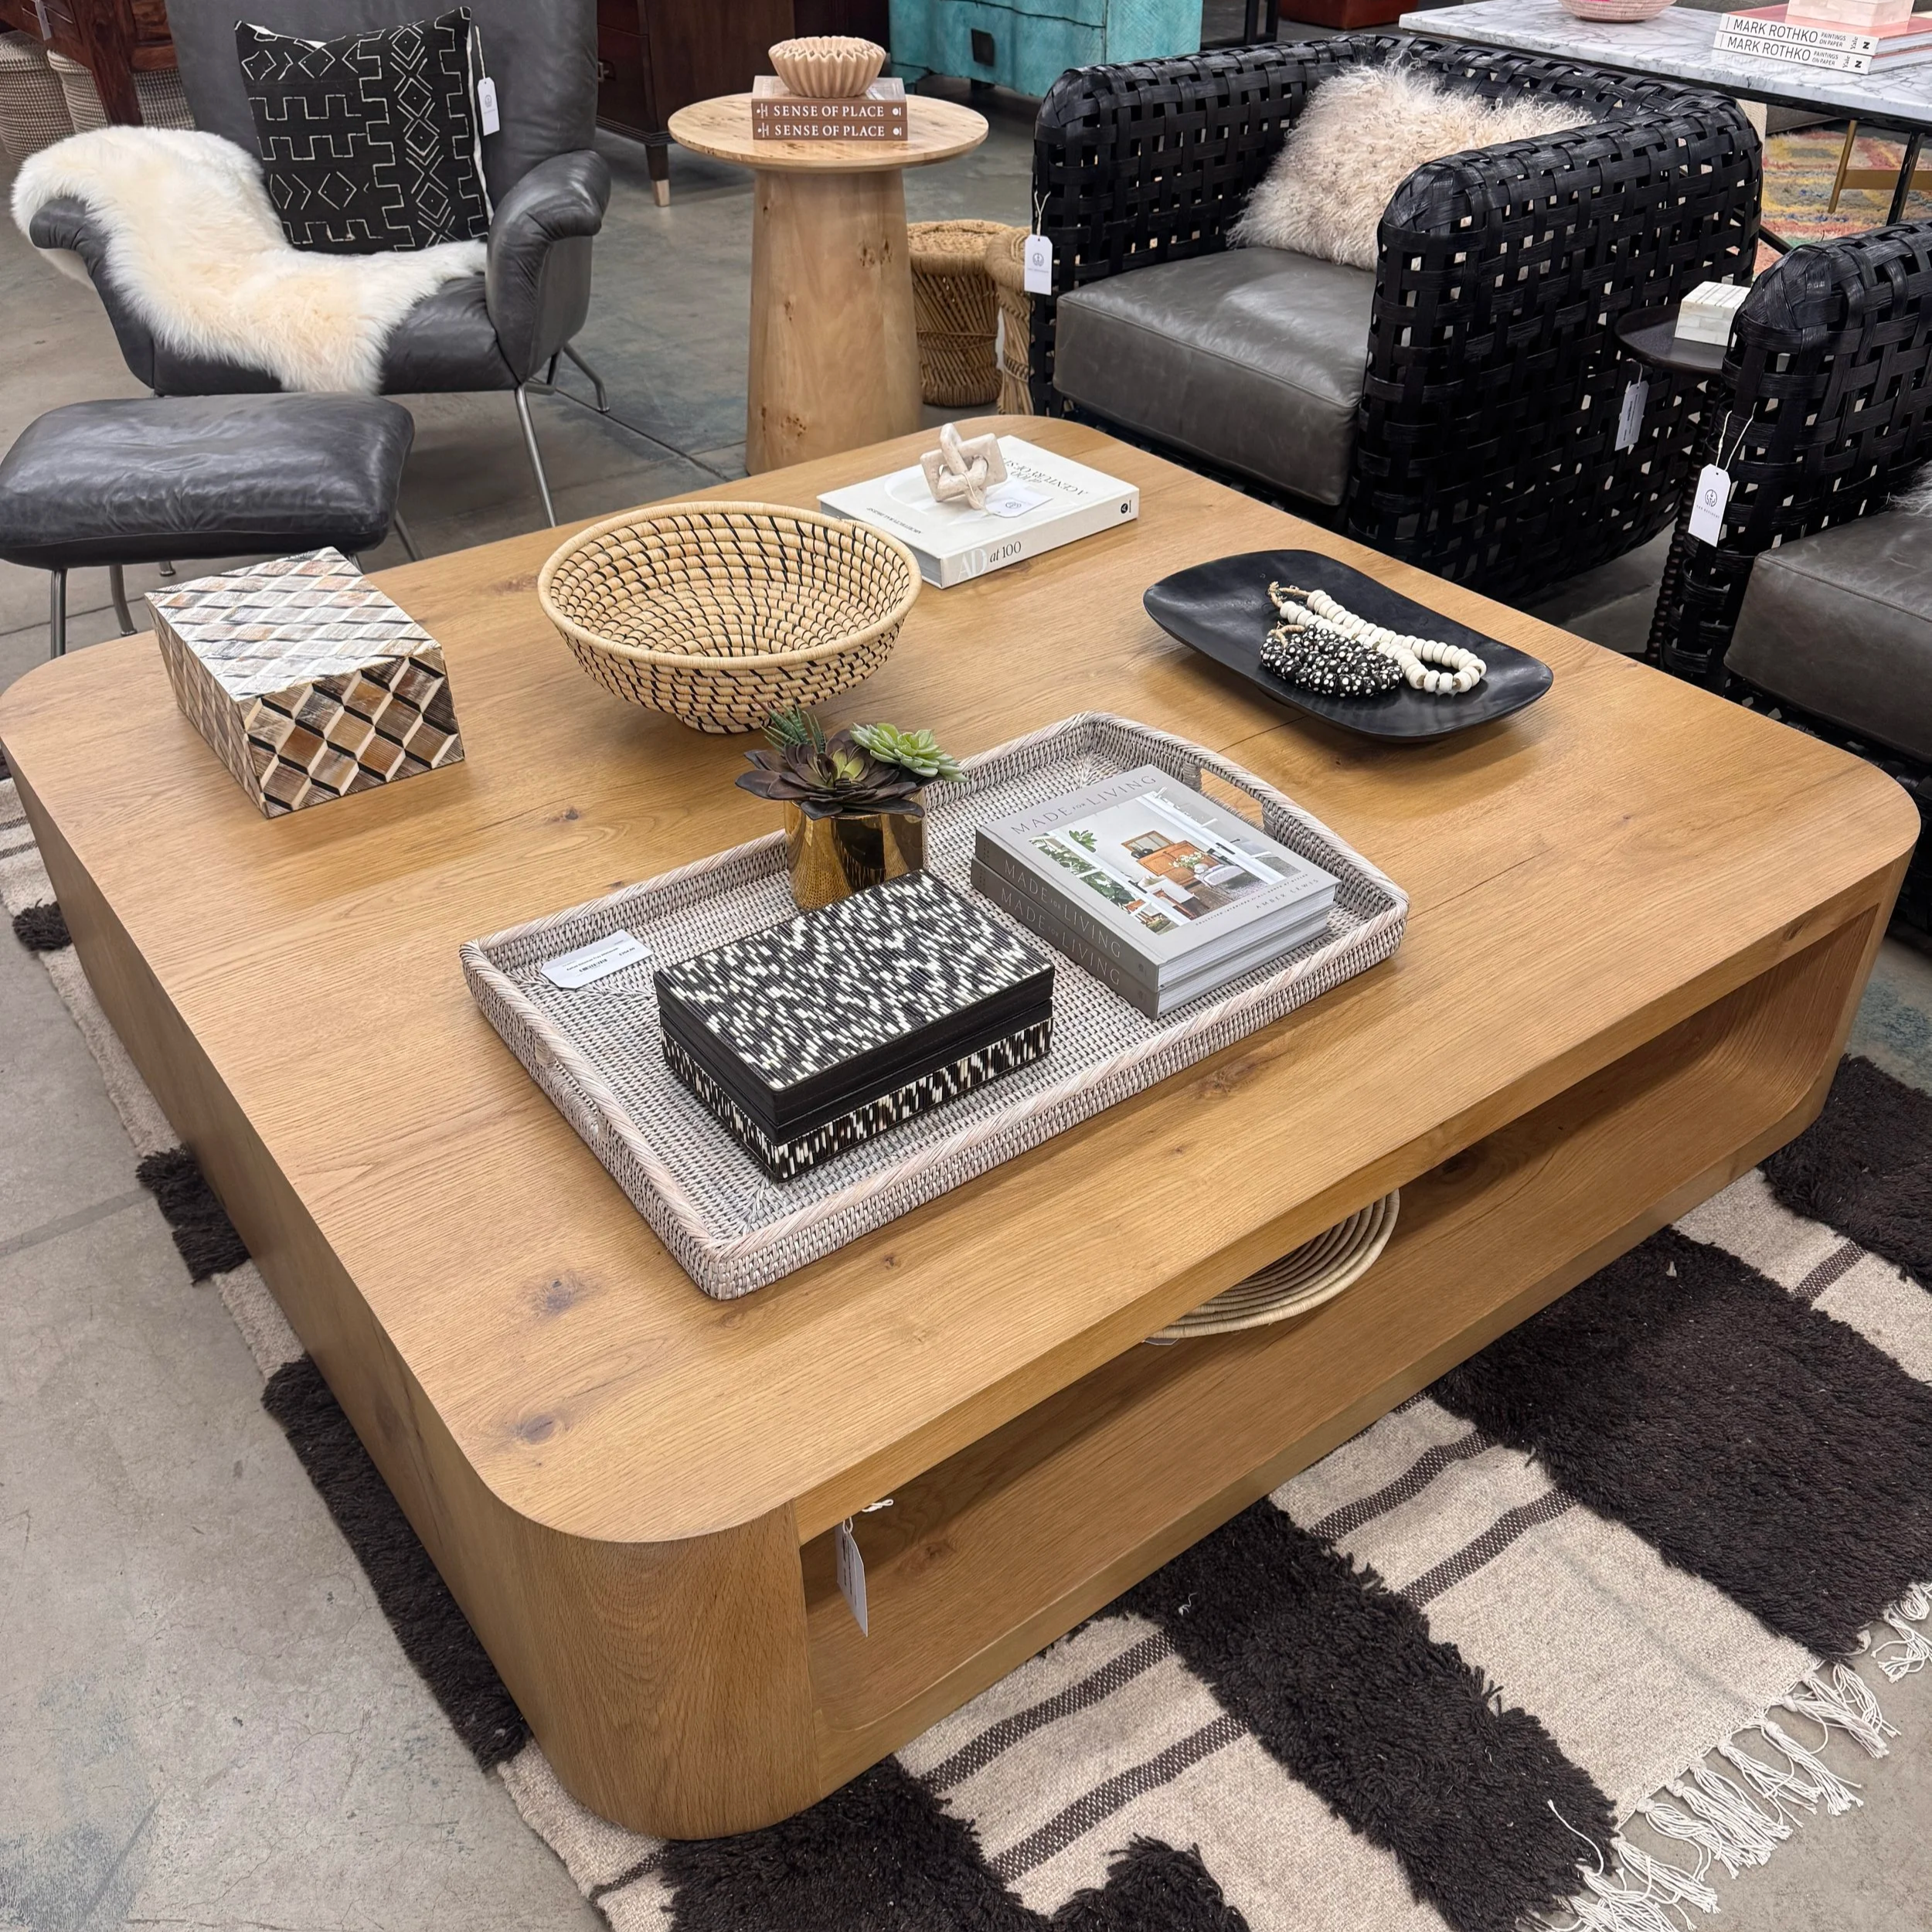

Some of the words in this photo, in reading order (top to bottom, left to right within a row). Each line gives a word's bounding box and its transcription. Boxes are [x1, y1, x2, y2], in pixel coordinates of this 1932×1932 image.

[1733, 19, 1767, 36] MARK
[1769, 26, 1818, 43] ROTHKO
[1821, 32, 1845, 41] PAINTINGS
[1727, 36, 1760, 53] MARK
[1763, 43, 1811, 61] ROTHKO
[1814, 51, 1838, 60] PAINTINGS
[774, 106, 818, 117] SENSE
[821, 106, 838, 117] OF
[842, 106, 884, 117] PLACE
[774, 125, 819, 136] SENSE
[822, 125, 839, 136] OF
[843, 126, 885, 137] PLACE
[957, 548, 988, 582] AD
[989, 549, 1000, 563] at
[1002, 542, 1022, 559] 100
[1011, 808, 1073, 835] MADE
[1087, 775, 1156, 806] LIVING
[1256, 893, 1286, 909] AMBER
[1290, 879, 1319, 893] LEWIS
[1005, 859, 1047, 903] MADE
[1050, 899, 1061, 910] FOR
[1064, 904, 1121, 958] LIVING
[1001, 888, 1045, 931] MADE
[1062, 932, 1119, 985] LIVING
